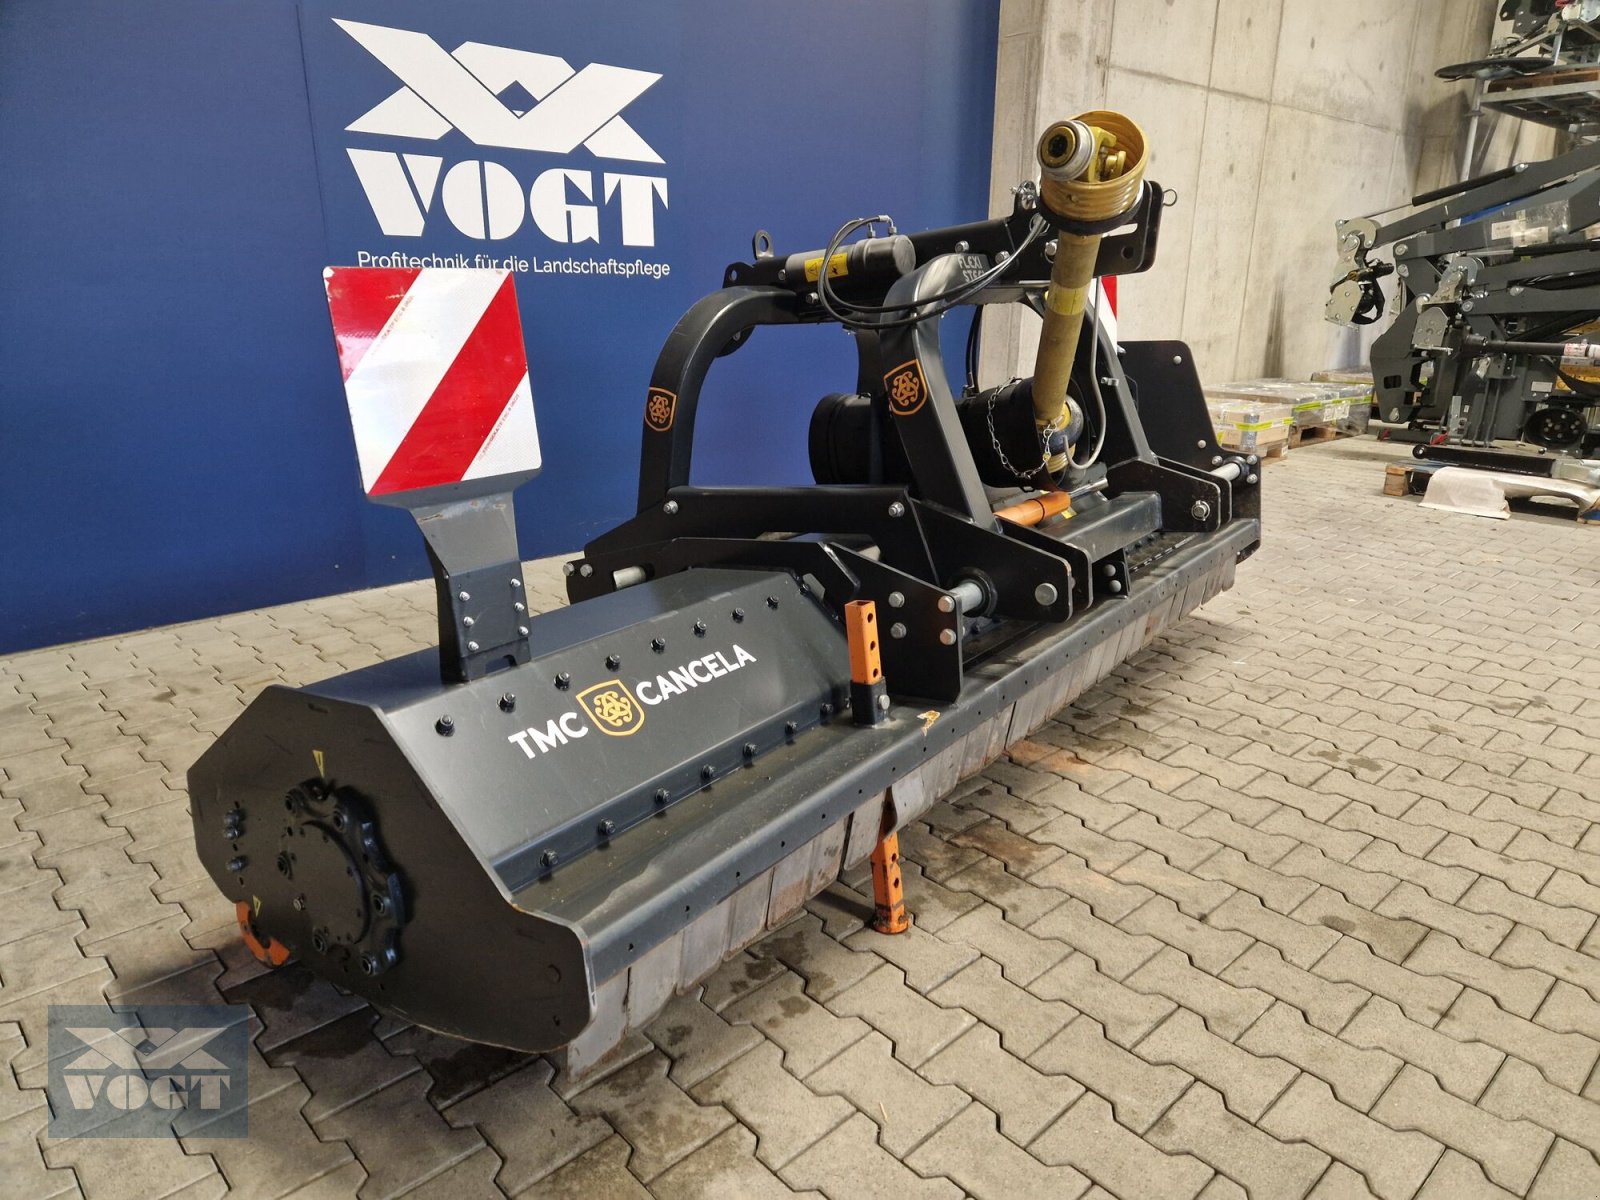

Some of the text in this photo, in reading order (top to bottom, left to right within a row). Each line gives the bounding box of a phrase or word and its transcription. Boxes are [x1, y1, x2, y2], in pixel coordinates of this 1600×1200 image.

[346, 148, 669, 248] VOGT
[358, 250, 671, 279] Profitechnik für die Landschaftspflege
[957, 255, 983, 269] FLEXI
[507, 644, 758, 760] TMC CANCELA
